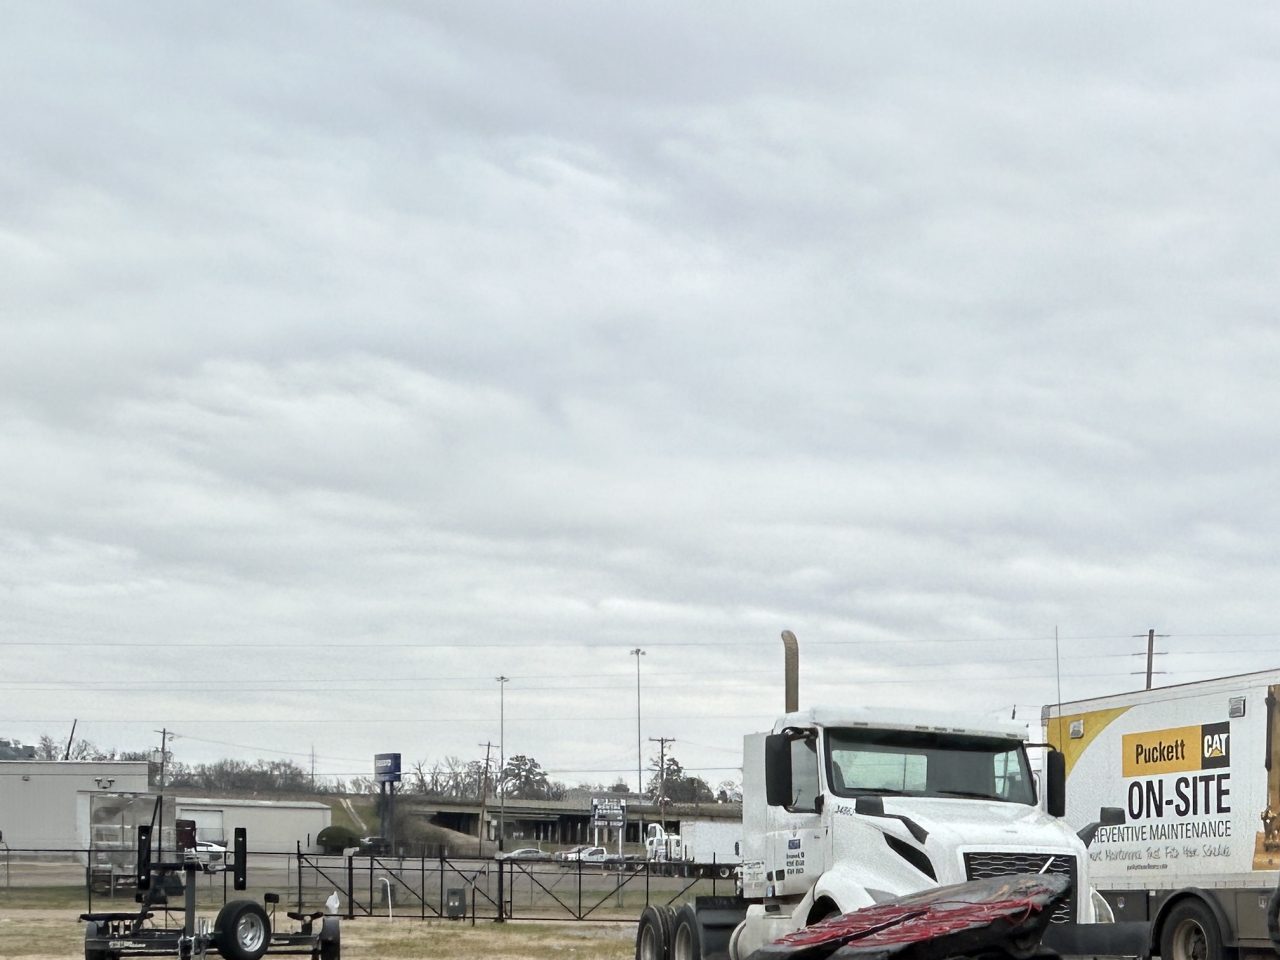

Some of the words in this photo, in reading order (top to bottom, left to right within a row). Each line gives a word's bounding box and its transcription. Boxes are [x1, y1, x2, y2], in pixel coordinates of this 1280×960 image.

[1135, 739, 1186, 765] Puckett
[1203, 733, 1230, 758] CAT
[1128, 773, 1231, 820] ON-SITE
[1093, 825, 1148, 843] REVENTIVE
[1149, 820, 1232, 841] MAINTENANCE
